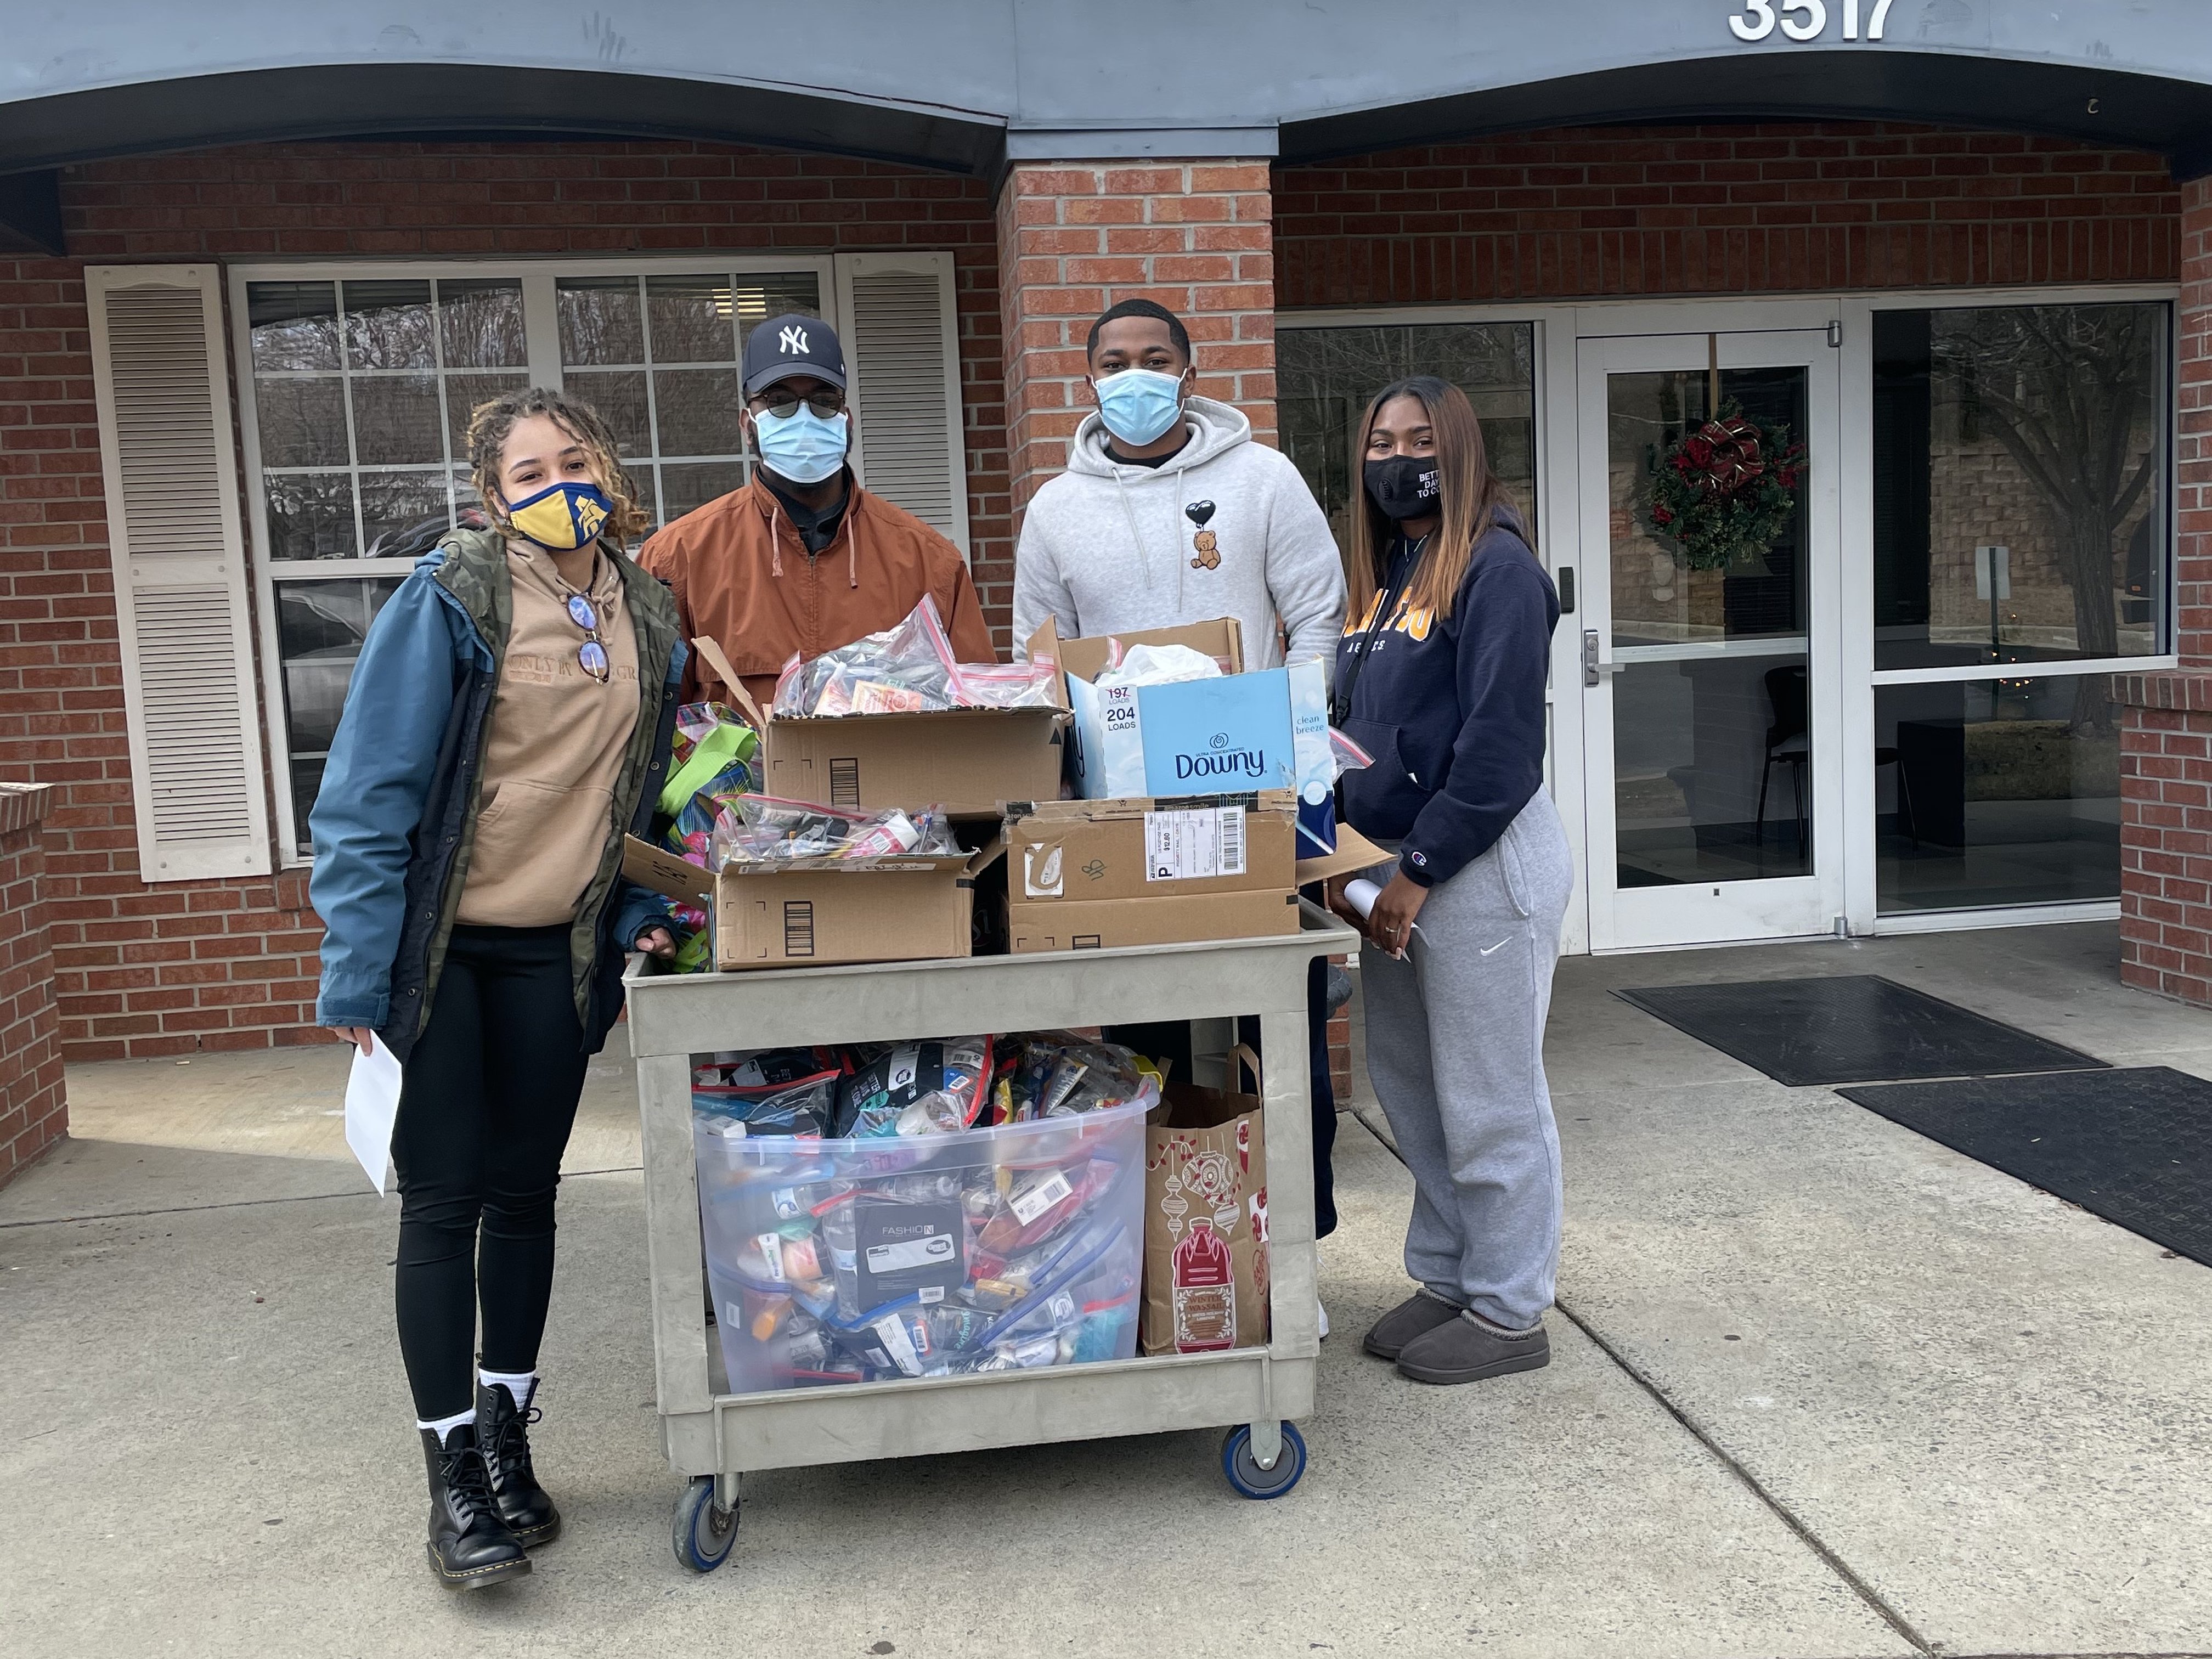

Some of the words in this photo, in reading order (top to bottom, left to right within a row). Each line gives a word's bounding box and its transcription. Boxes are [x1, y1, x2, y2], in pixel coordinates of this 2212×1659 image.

[1729, 0, 1892, 41] 3517
[778, 325, 810, 354] NY
[1419, 469, 1440, 482] BETT
[1425, 478, 1440, 489] DAY
[1417, 489, 1429, 498] TO
[509, 654, 555, 673] ONLY
[1110, 687, 1128, 699] 197
[1107, 707, 1135, 721] 204
[1108, 721, 1136, 731] LOADS
[1297, 716, 1319, 725] clean
[1296, 725, 1324, 735] breeze
[1175, 749, 1265, 779] Downy
[1158, 867, 1173, 878] P
[882, 1224, 934, 1234] FASHION
[1188, 1303, 1223, 1311] WASSAIL
